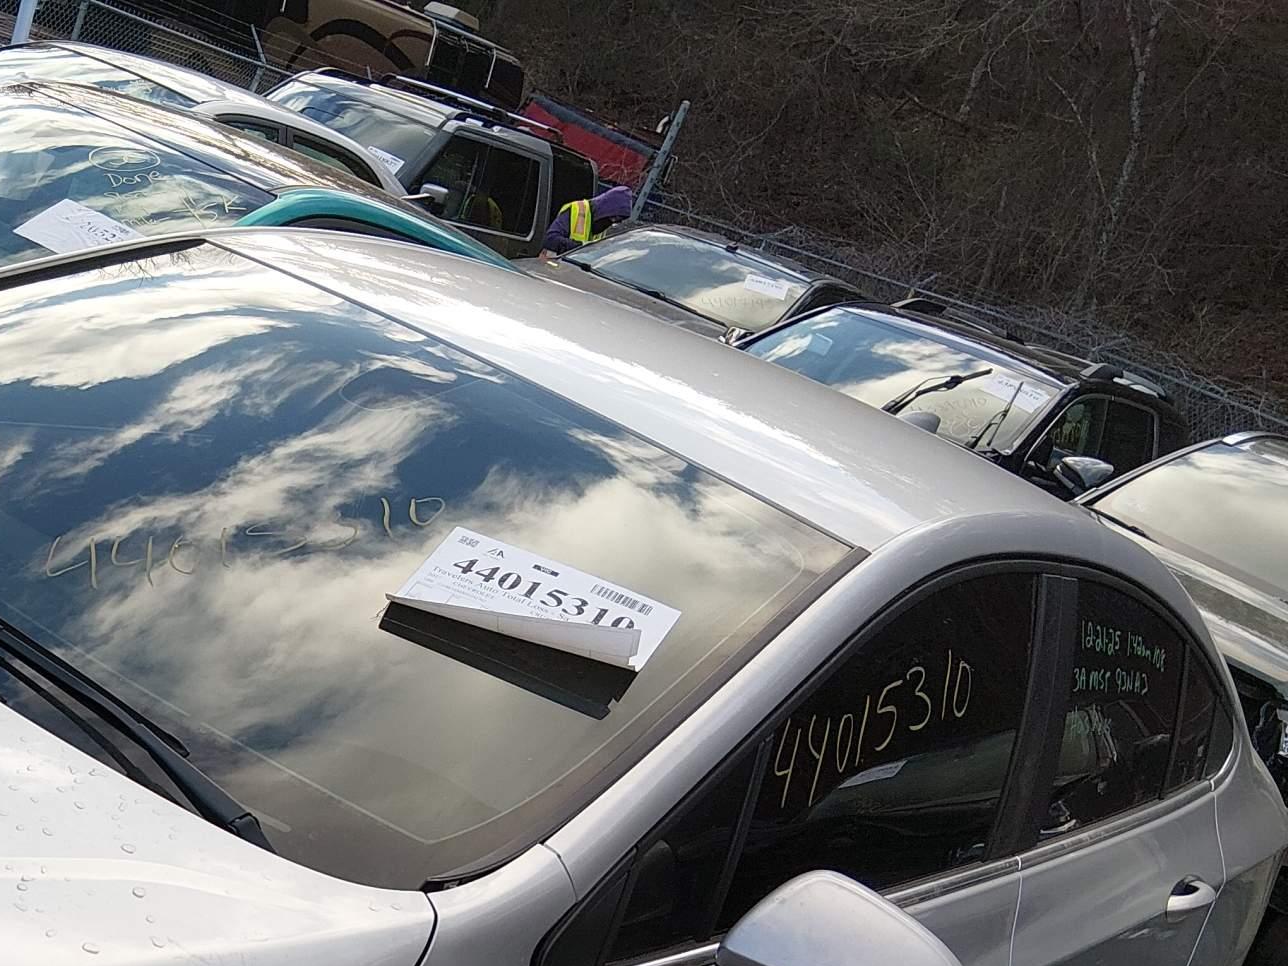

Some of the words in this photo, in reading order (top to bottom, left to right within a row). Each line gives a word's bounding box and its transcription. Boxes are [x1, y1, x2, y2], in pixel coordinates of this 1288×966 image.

[433, 566, 474, 585] Travelers
[501, 589, 529, 605] Total
[452, 557, 635, 630] 44015310
[774, 649, 973, 808] 44015310
